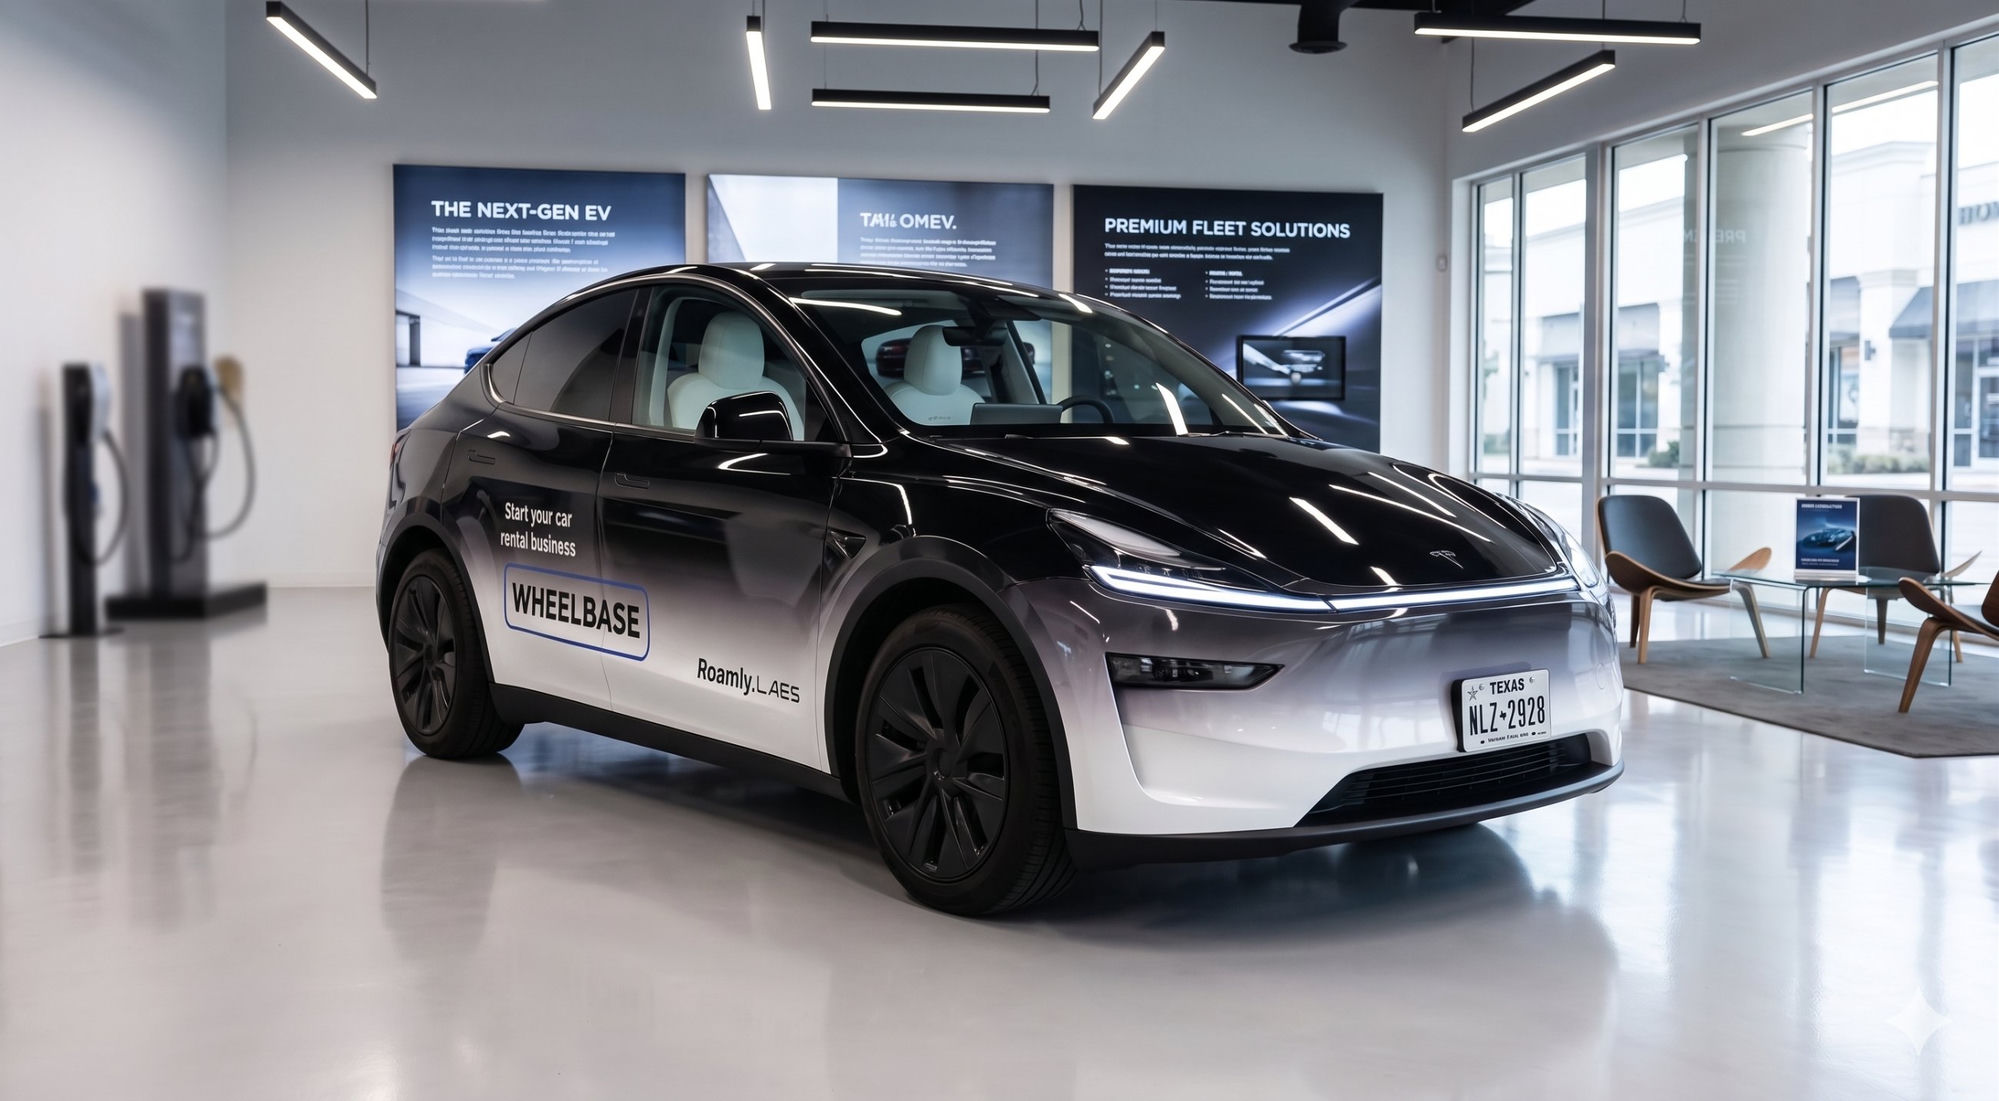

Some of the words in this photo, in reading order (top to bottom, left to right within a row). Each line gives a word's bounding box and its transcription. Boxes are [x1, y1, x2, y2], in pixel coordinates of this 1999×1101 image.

[431, 200, 472, 218] THE
[477, 202, 579, 221] NEXT-GEN
[585, 205, 612, 221] EV
[899, 214, 957, 230] OMEV.
[1104, 218, 1187, 235] PREMIUM
[1192, 221, 1247, 236] FLEET
[1250, 222, 1351, 238] SOLUTIONS
[505, 502, 529, 522] Start
[530, 509, 553, 527] your
[555, 512, 573, 528] car
[500, 531, 528, 550] rental
[531, 532, 576, 557] business
[512, 582, 640, 639] WHEELBASE
[1490, 678, 1525, 695] TEXAS
